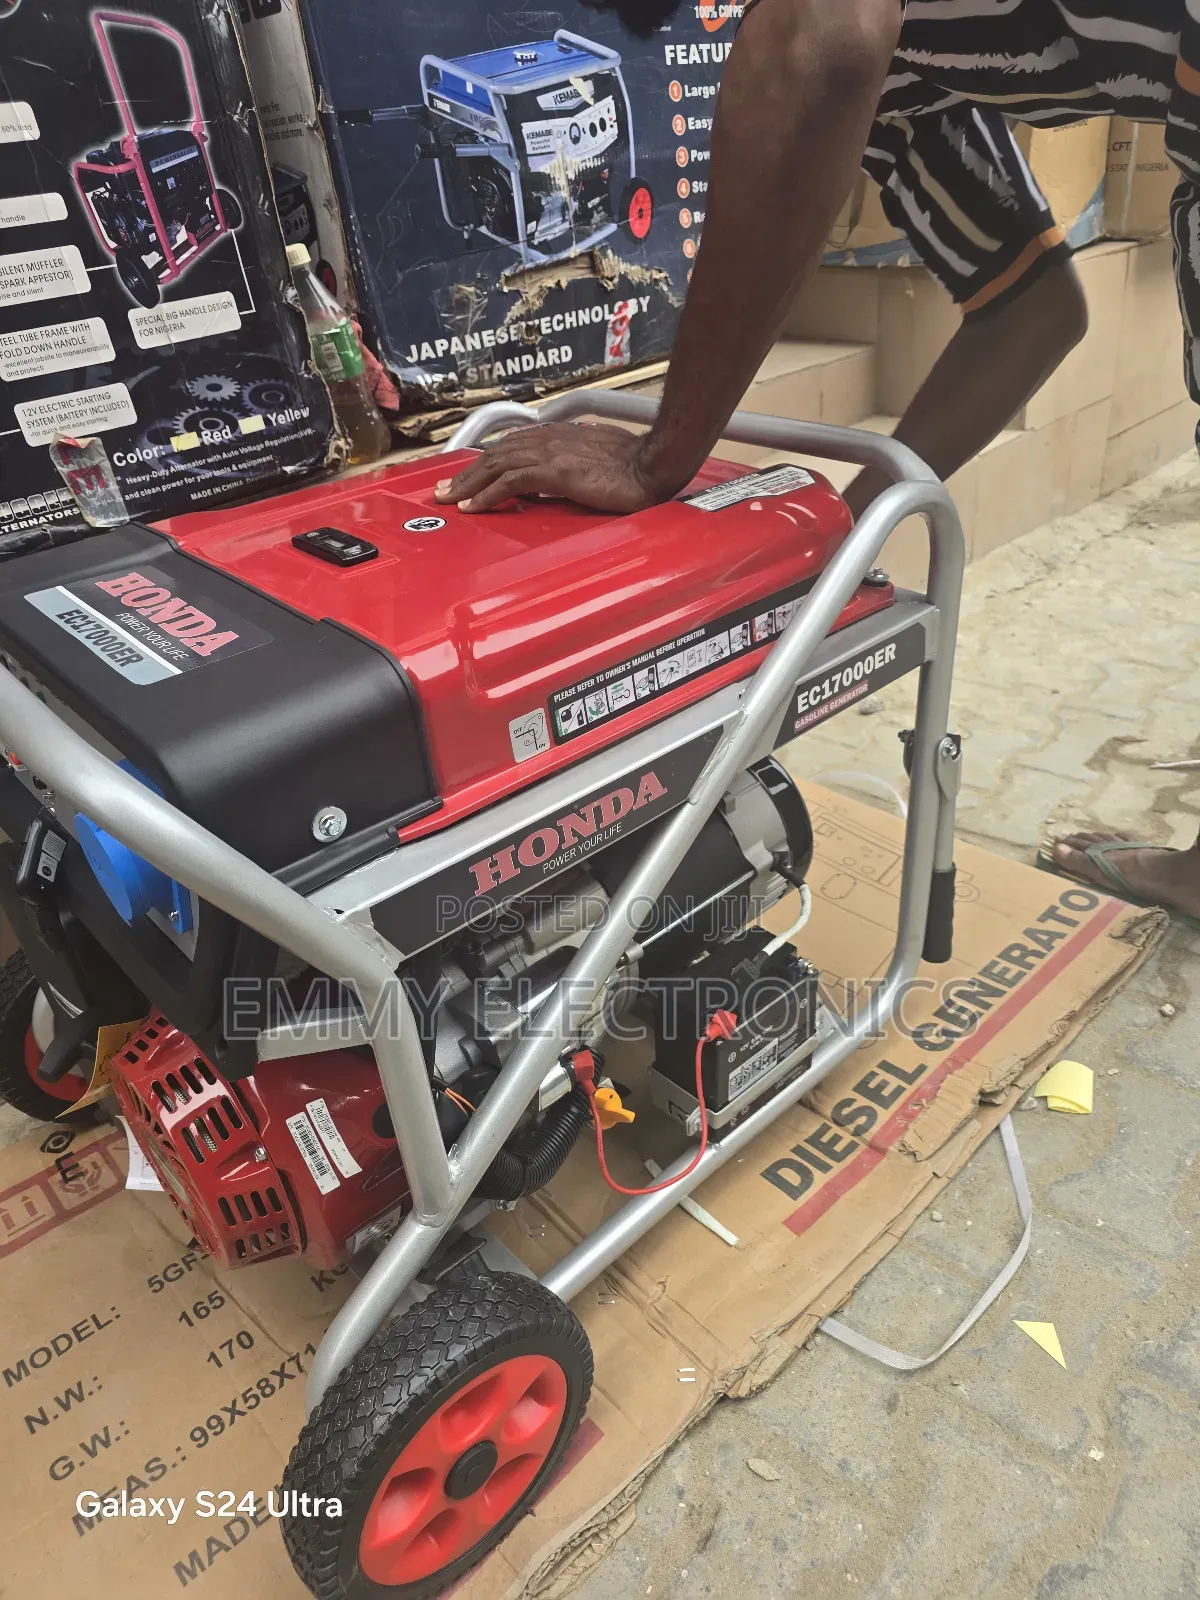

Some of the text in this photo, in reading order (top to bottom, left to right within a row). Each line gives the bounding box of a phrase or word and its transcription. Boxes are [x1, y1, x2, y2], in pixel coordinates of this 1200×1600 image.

[684, 84, 716, 99] Large
[687, 116, 714, 131] Easy
[1, 213, 26, 224] handle
[26, 258, 65, 273] MUFFLER
[135, 300, 234, 327] SPECIAL BIG HANDLE DESIGN
[138, 322, 186, 338] FOR NIGERIA
[19, 331, 39, 343] TUBE
[39, 326, 69, 339] FRAME
[70, 322, 91, 334] WITH
[24, 341, 53, 356] DOWN
[54, 335, 87, 350] HANDLE
[465, 345, 573, 385] STANDARD
[22, 391, 112, 418] 12V ELECTRIC STARTING
[26, 415, 55, 430] SYSTEM
[112, 444, 167, 468] Color:
[201, 424, 233, 445] Red
[169, 455, 207, 473] Alternator
[206, 453, 223, 465] with
[222, 447, 240, 461] Auto
[140, 486, 162, 498] clean
[161, 480, 184, 495] power
[184, 475, 196, 485] for
[195, 472, 214, 485] your
[190, 480, 244, 501] MADE IN CHINA
[95, 571, 240, 656] HONDA
[115, 612, 150, 633] POWER
[142, 630, 172, 649] YOUR
[55, 608, 145, 668] EC17000ER
[553, 685, 577, 703] PLEASE
[576, 678, 596, 693] REFER
[596, 673, 605, 685] TO
[632, 650, 656, 669] MANUAL
[656, 642, 677, 657] BEFORE
[676, 628, 706, 647] OPERATION
[797, 642, 897, 714] EC17000ER
[794, 683, 868, 730] GASOLINE GENERATOR
[468, 771, 668, 896] HONDA
[542, 821, 623, 875] POWER YOUR LIFE
[759, 1059, 930, 1202] DIESEL
[1, 1305, 122, 1389] MODEL:
[23, 1375, 104, 1435] N.W.:
[177, 1290, 227, 1330] 165
[48, 1330, 256, 1484] G.W.: 170
